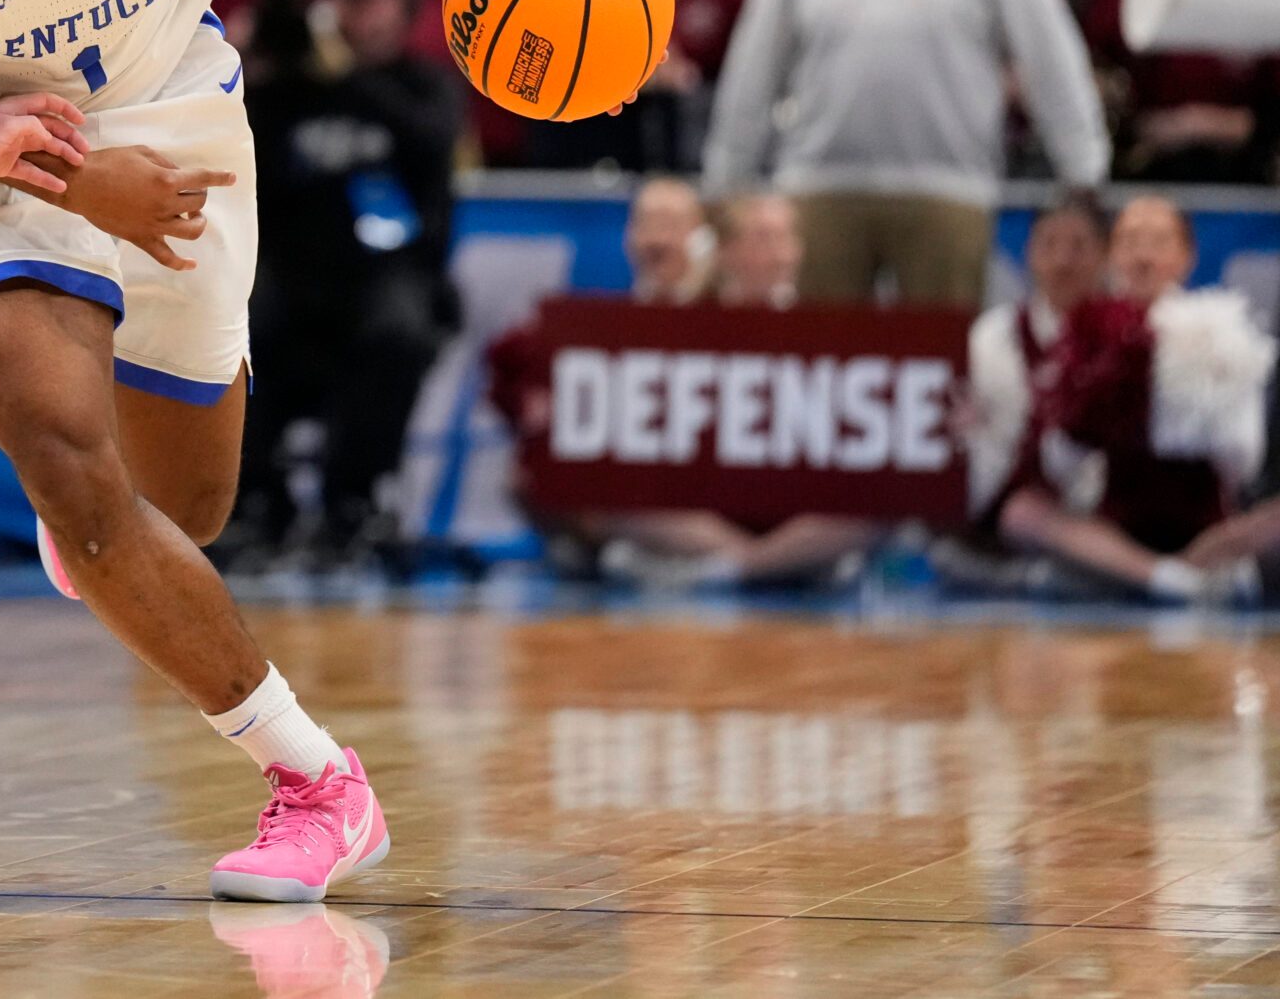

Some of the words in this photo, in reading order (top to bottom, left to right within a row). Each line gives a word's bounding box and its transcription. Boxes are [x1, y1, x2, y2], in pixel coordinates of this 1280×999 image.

[71, 44, 108, 95] 1
[510, 50, 532, 88] MARCH
[523, 38, 551, 89] MADNESS
[550, 349, 953, 472] DEFENSE
